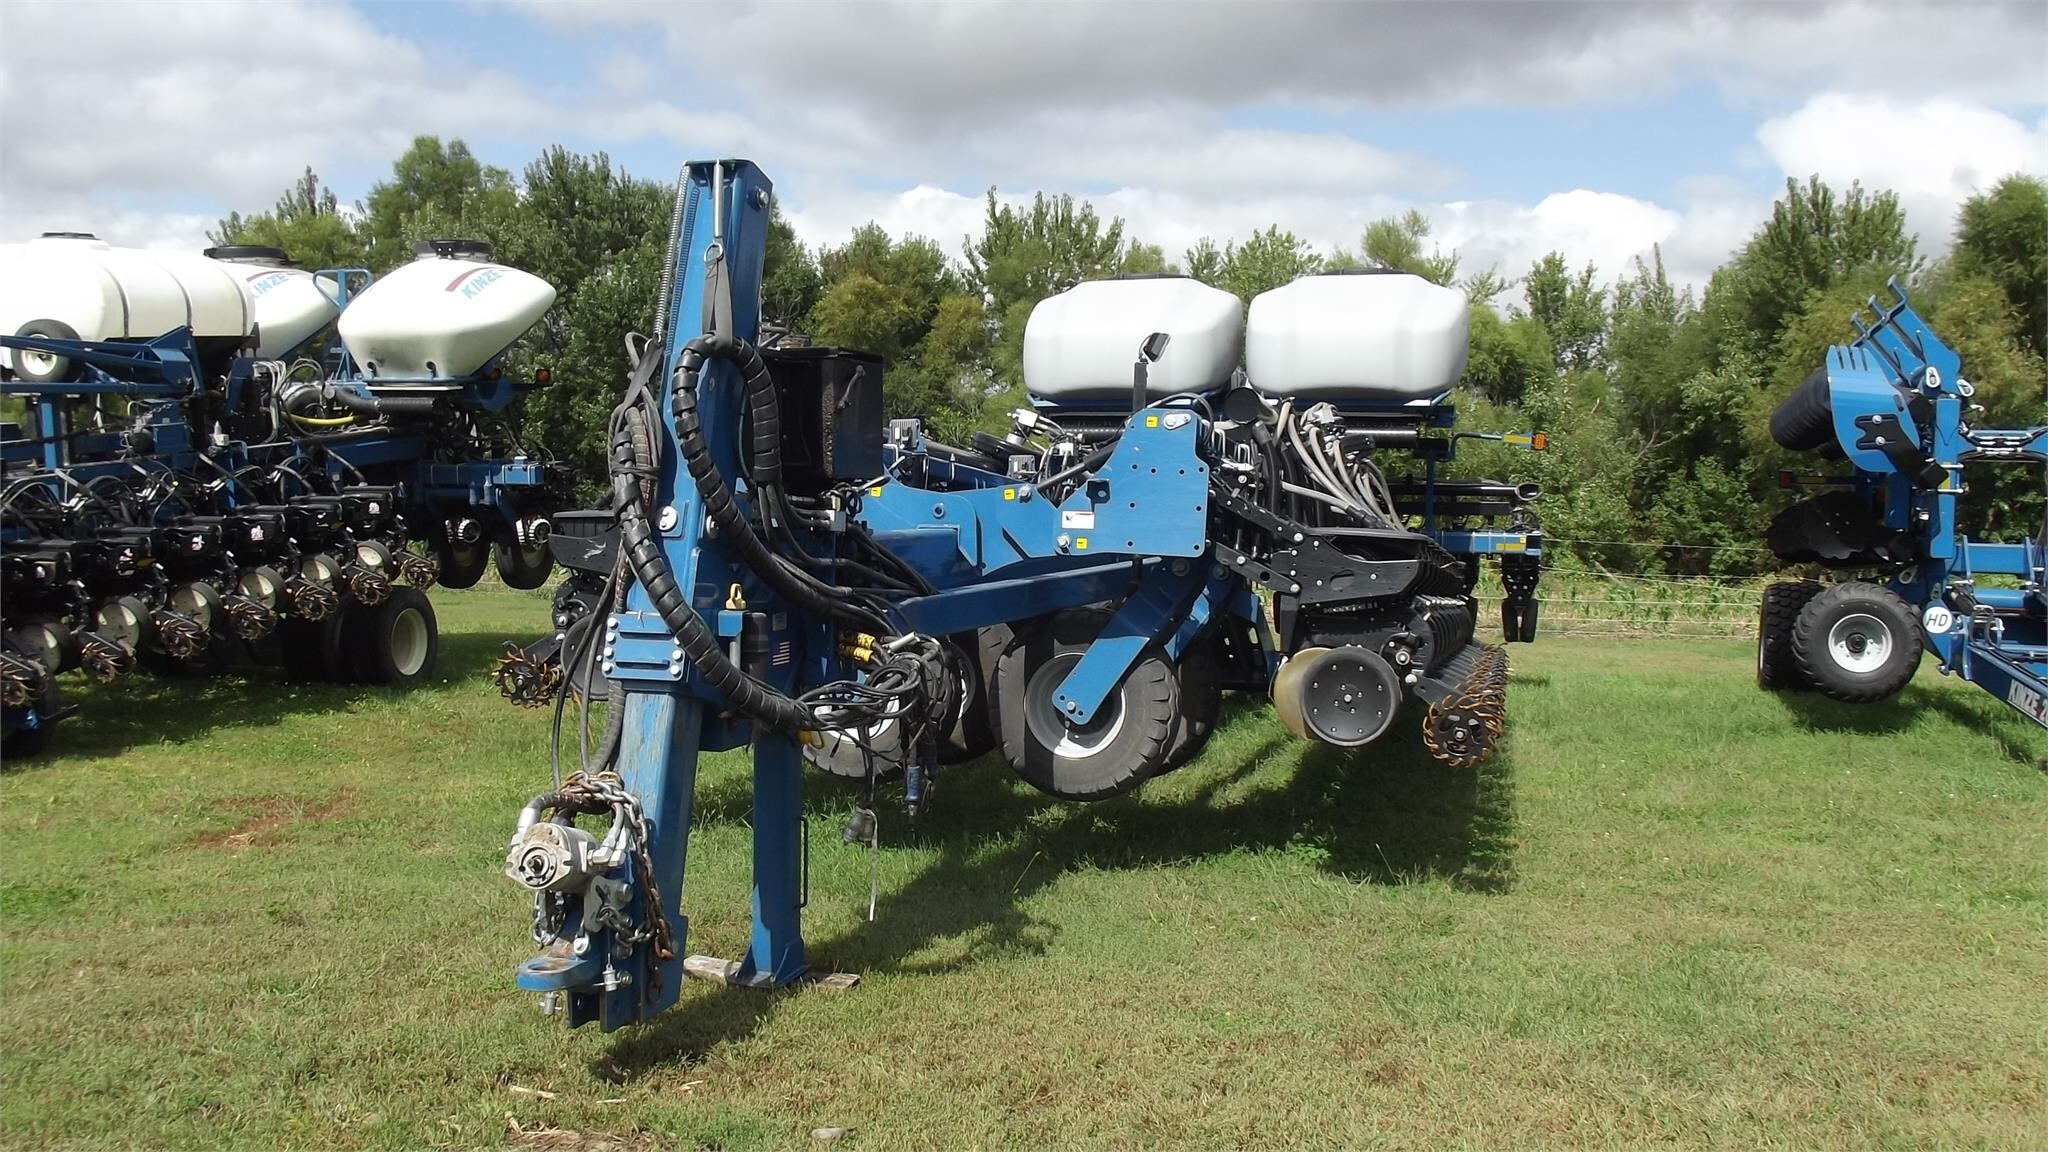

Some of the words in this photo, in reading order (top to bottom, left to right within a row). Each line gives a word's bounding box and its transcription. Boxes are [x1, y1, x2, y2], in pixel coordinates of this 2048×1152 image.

[252, 273, 289, 296] INZE
[462, 269, 503, 300] KINZE
[1926, 614, 1948, 626] HD
[2008, 679, 2040, 717] KINZE
